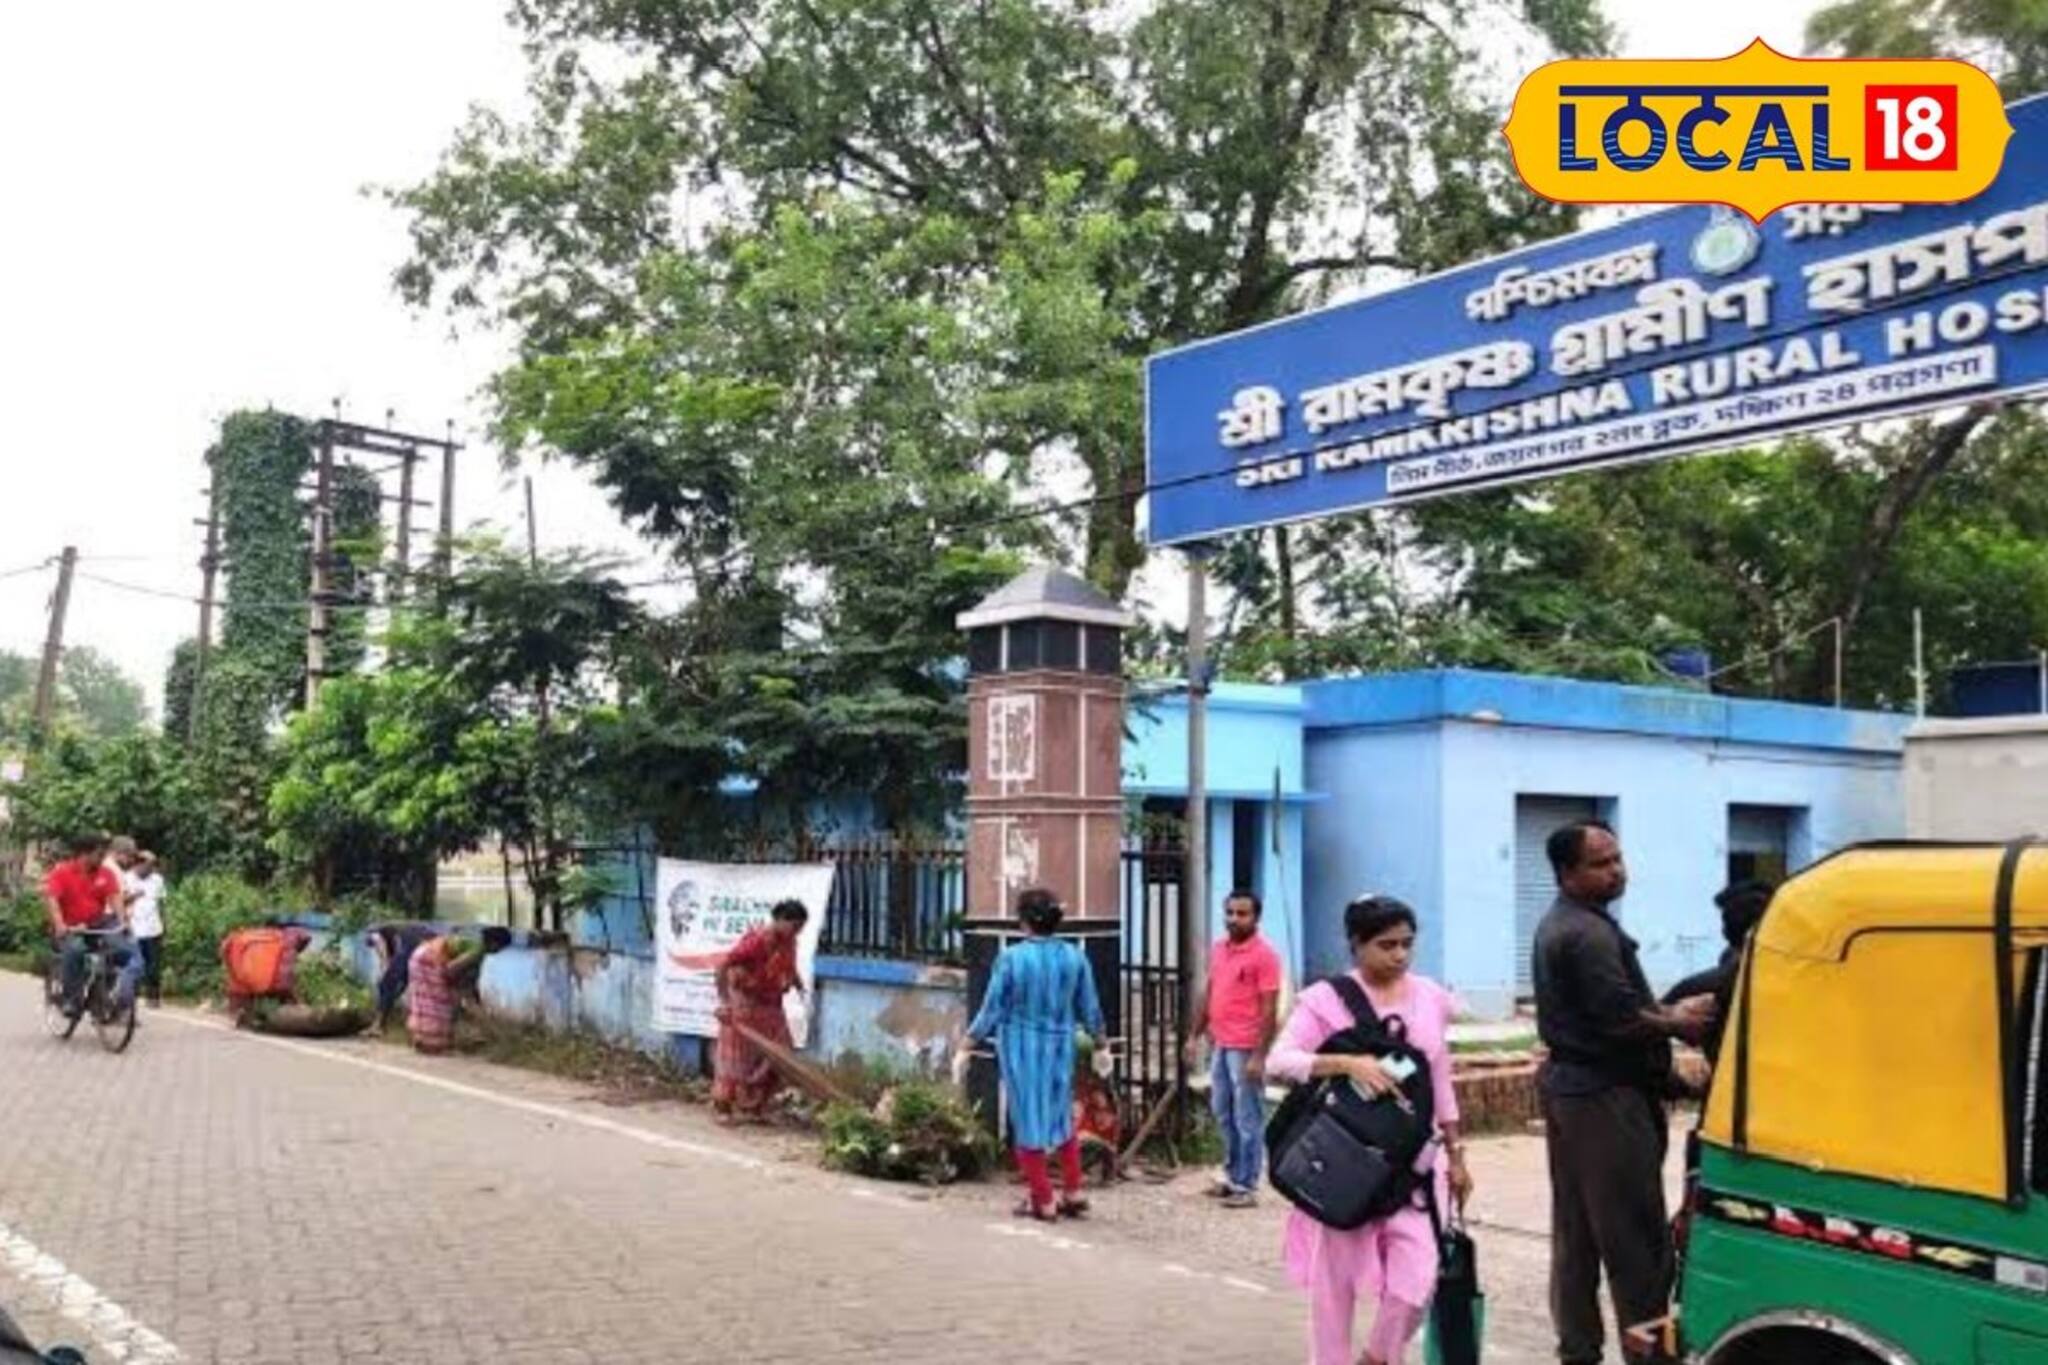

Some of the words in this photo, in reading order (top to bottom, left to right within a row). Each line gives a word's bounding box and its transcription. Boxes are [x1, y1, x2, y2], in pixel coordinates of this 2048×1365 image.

[1465, 241, 1658, 321] পশ্চিমবঙ্গ
[1217, 386, 1285, 448] শ্রী
[1235, 449, 1303, 487] SRI
[1651, 331, 1861, 405] RURAL
[1886, 284, 2048, 357] HOS
